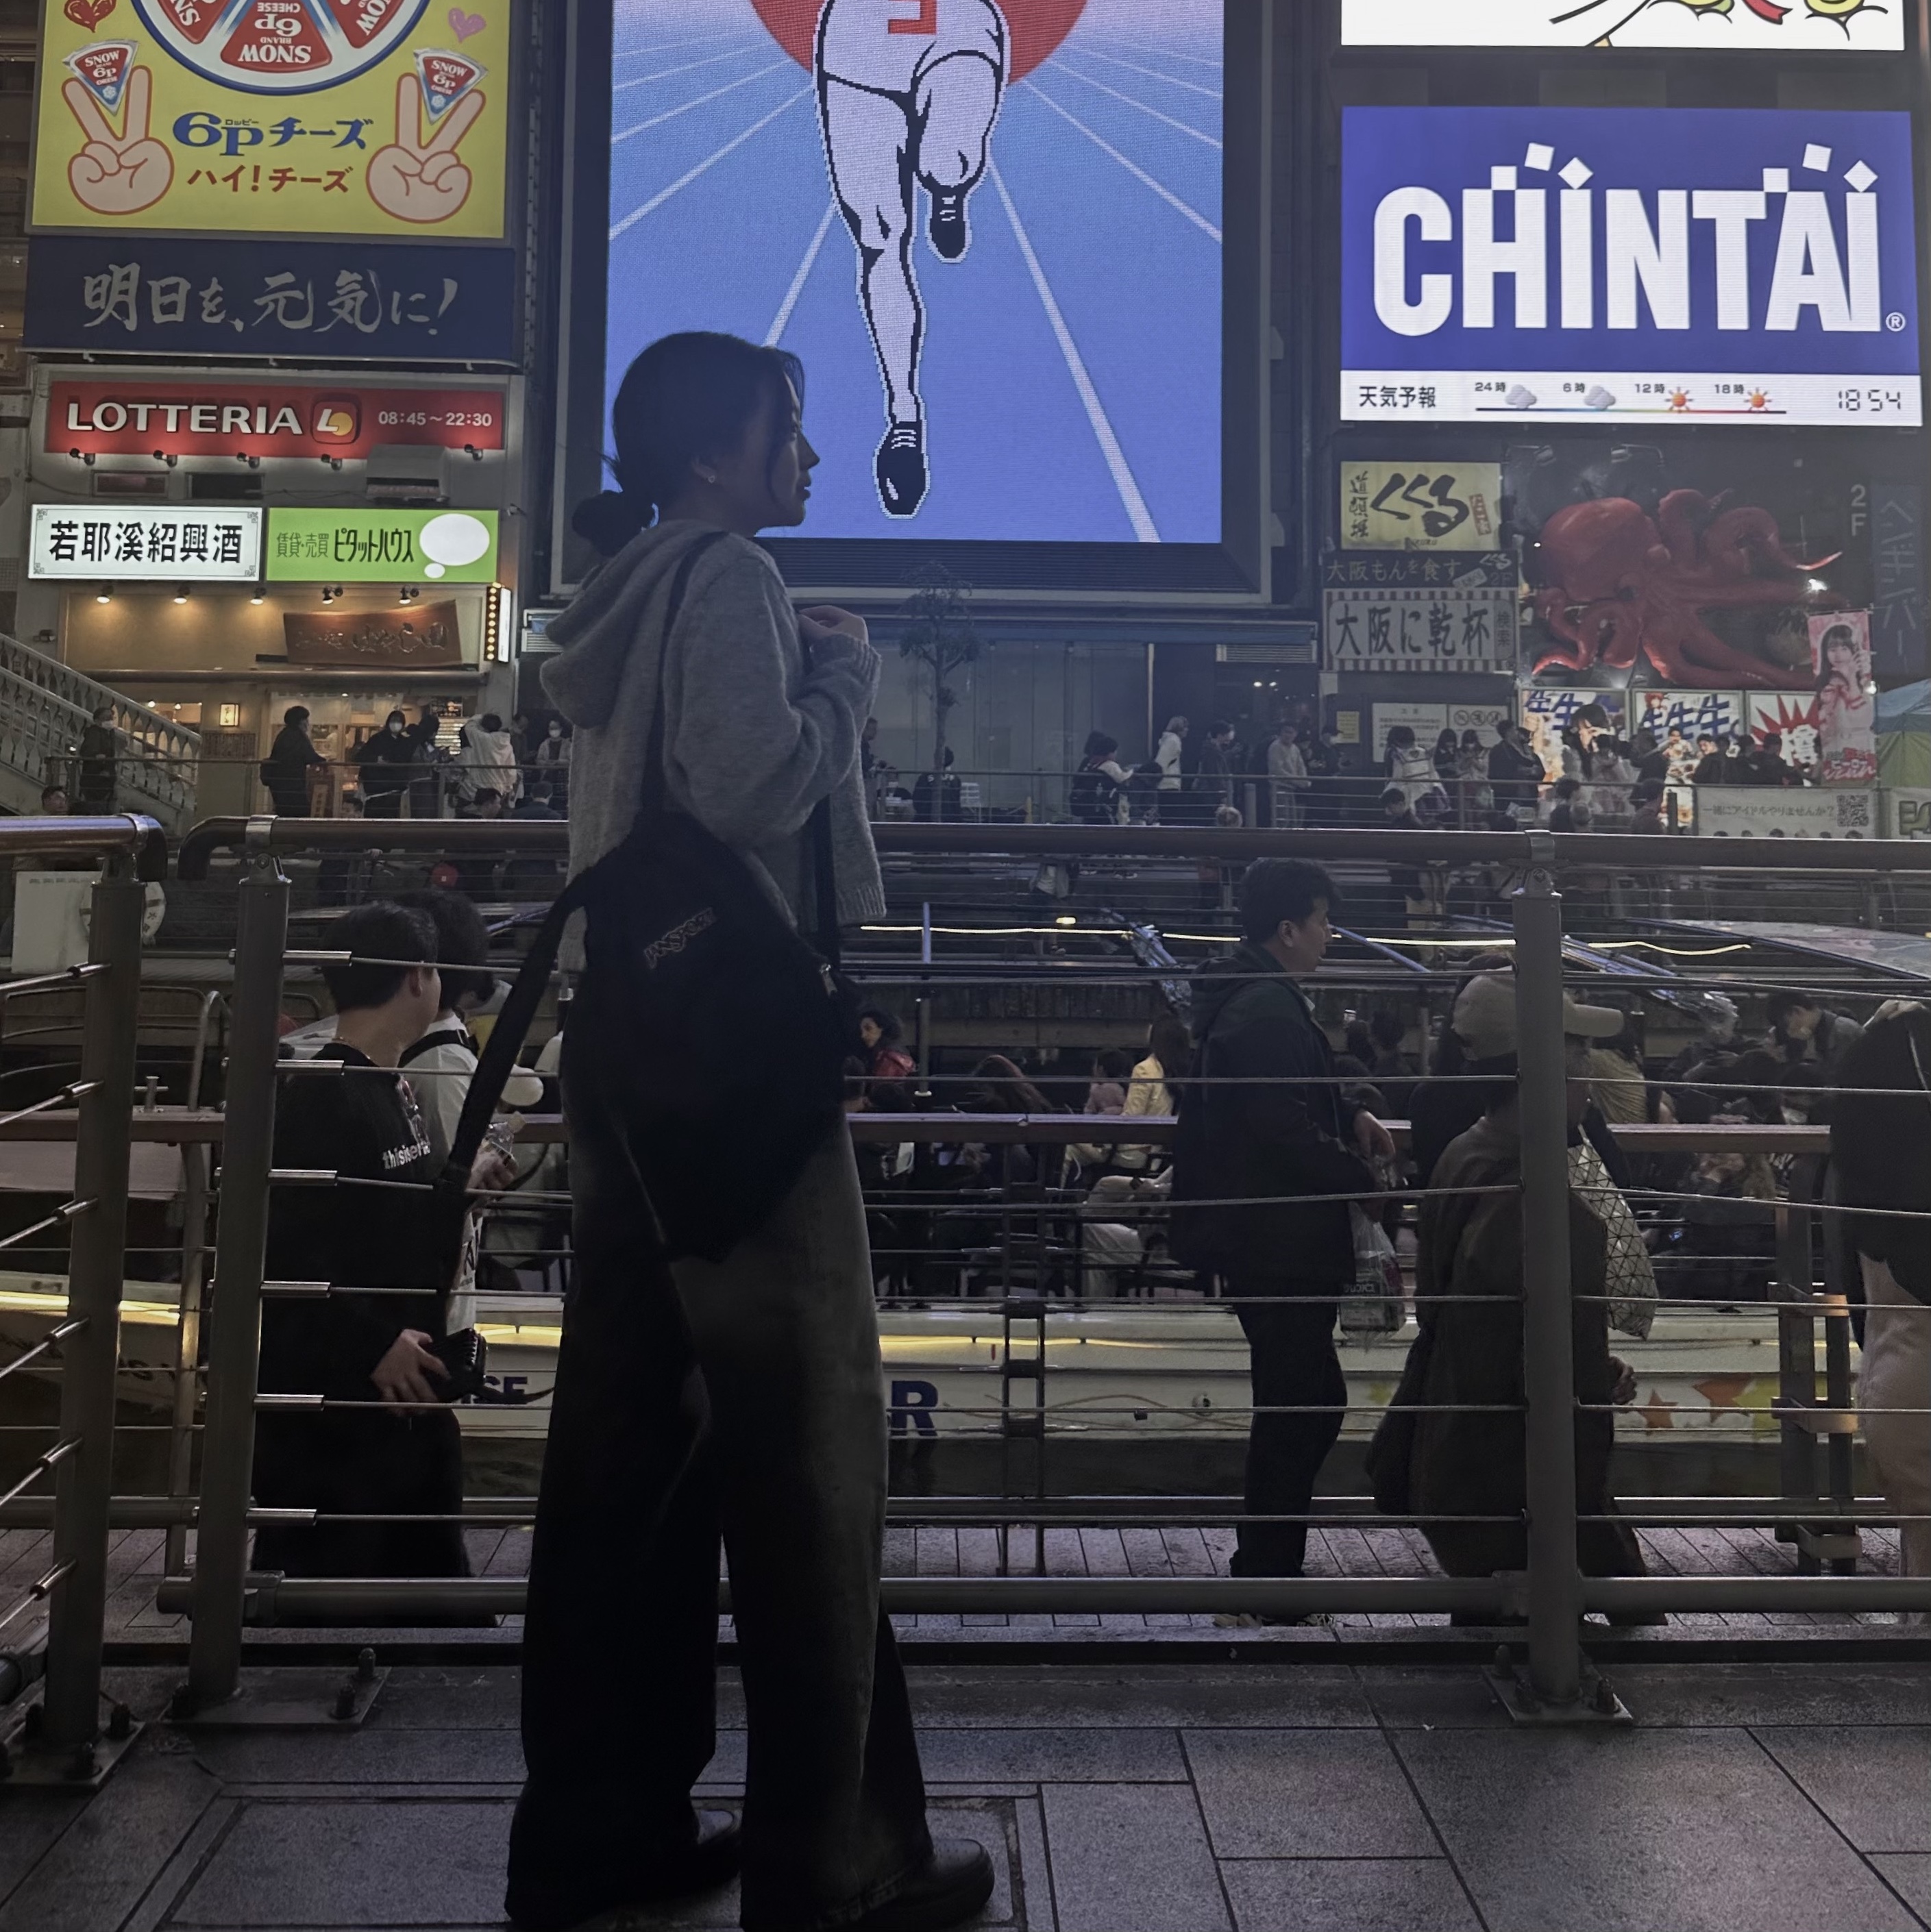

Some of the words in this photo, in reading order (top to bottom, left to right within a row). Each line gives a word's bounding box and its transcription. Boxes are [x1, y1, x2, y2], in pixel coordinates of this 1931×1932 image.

[256, 2, 301, 13] CHEESE
[260, 36, 292, 45] BRAND
[84, 50, 120, 67] SNOW
[238, 45, 312, 64] SNOW
[431, 60, 467, 77] SNOW
[1358, 386, 1436, 408] 天気予報
[1474, 382, 1507, 393] 24時
[1562, 382, 1586, 394] 6時
[1634, 383, 1666, 395] 12時
[1714, 384, 1745, 396] 18時
[67, 401, 304, 435] LOTTERIA
[1370, 473, 1471, 538] くくる
[49, 519, 243, 564] 若耶溪紹興酒
[333, 527, 415, 564] ピタットハウス
[1327, 558, 1462, 582] 大阪もんを食す
[1335, 601, 1490, 659] 大阪に乾杯
